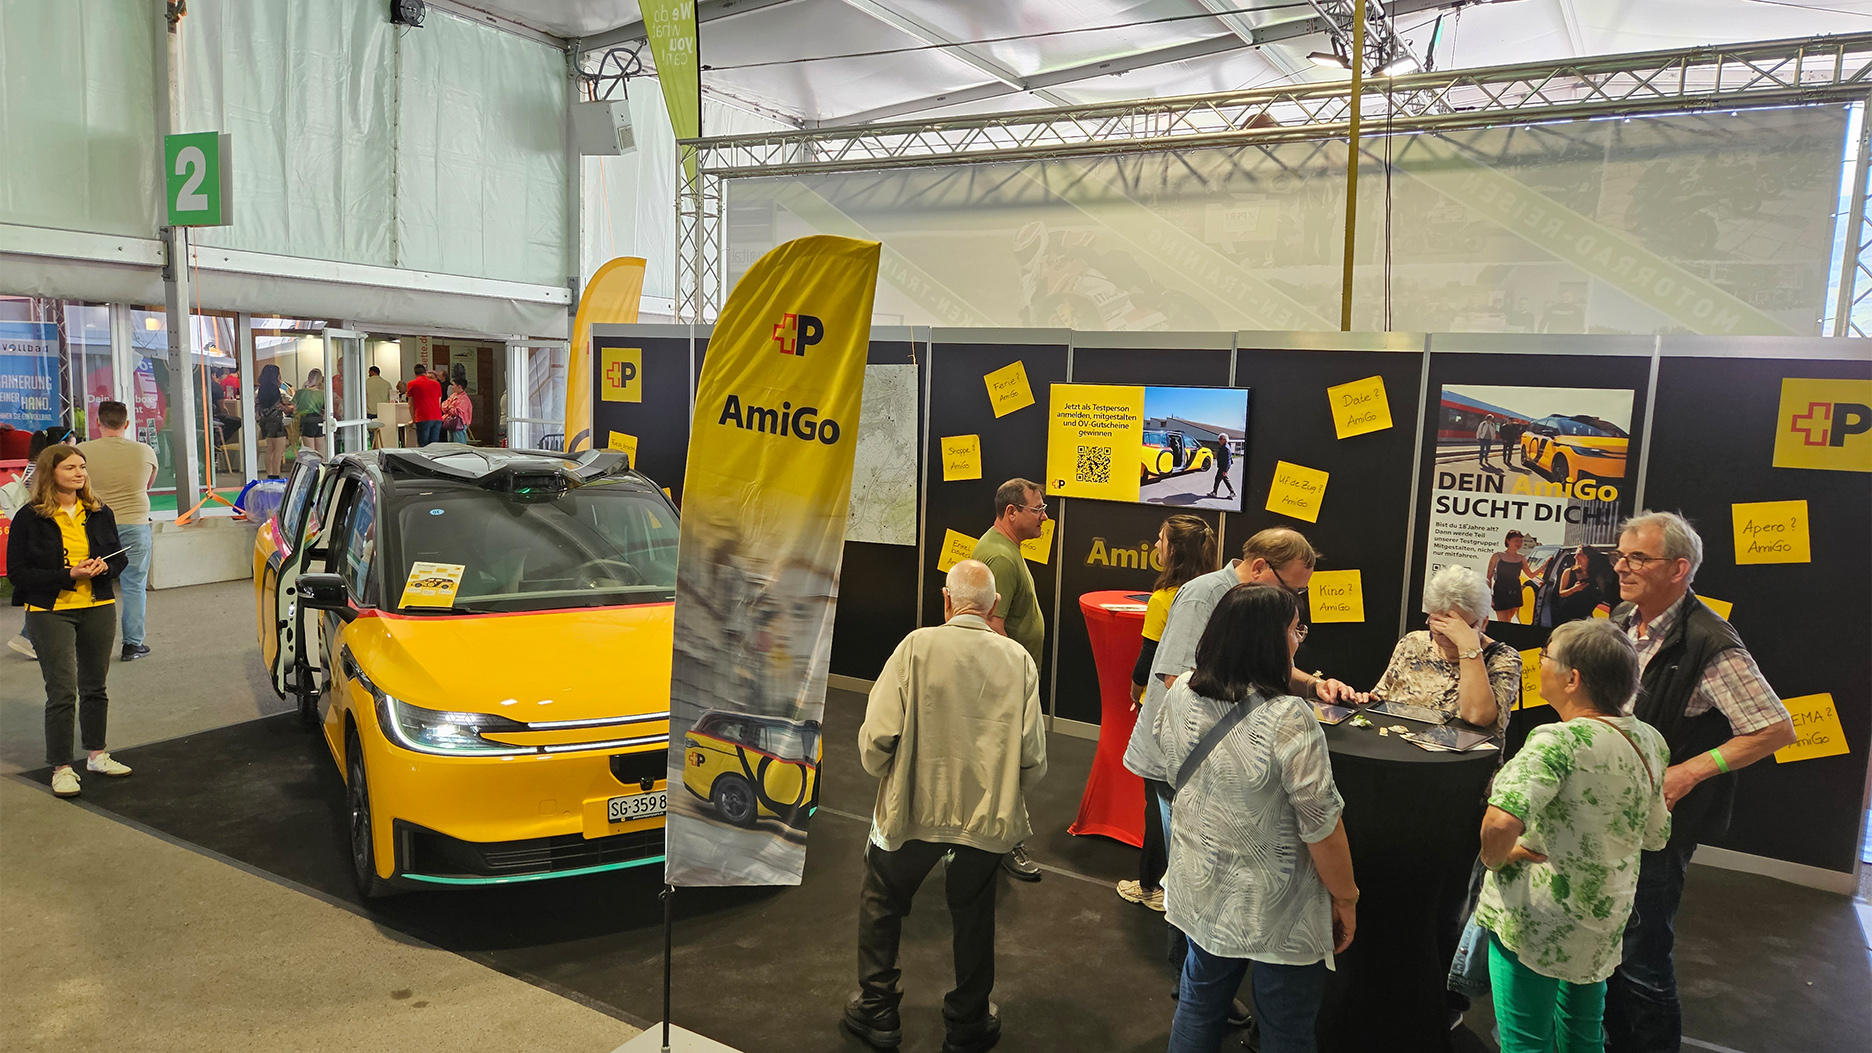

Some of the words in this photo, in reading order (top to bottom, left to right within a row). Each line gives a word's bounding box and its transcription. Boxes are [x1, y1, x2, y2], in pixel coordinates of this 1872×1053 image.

[175, 146, 208, 211] 2
[21, 396, 52, 411] HAND.
[88, 394, 110, 403] Dein
[1092, 404, 1130, 413] Testperson
[718, 394, 840, 445] AmiGo
[1057, 411, 1092, 420] anmelden,
[1093, 413, 1137, 421] mitgestalten
[1347, 411, 1377, 427] AmiGo
[1438, 472, 1505, 494] DEIN
[1510, 474, 1619, 502] AmiGo
[1281, 495, 1308, 508] AmiGo
[1435, 495, 1529, 520] SUCHT
[1534, 503, 1611, 526] DICH!
[1433, 543, 1477, 552] Mitgestalten,
[1459, 538, 1500, 547] Testgruppe!
[1747, 540, 1792, 554] AmiGo
[1444, 551, 1480, 560] mitfahren.
[1319, 602, 1351, 611] AmiGo
